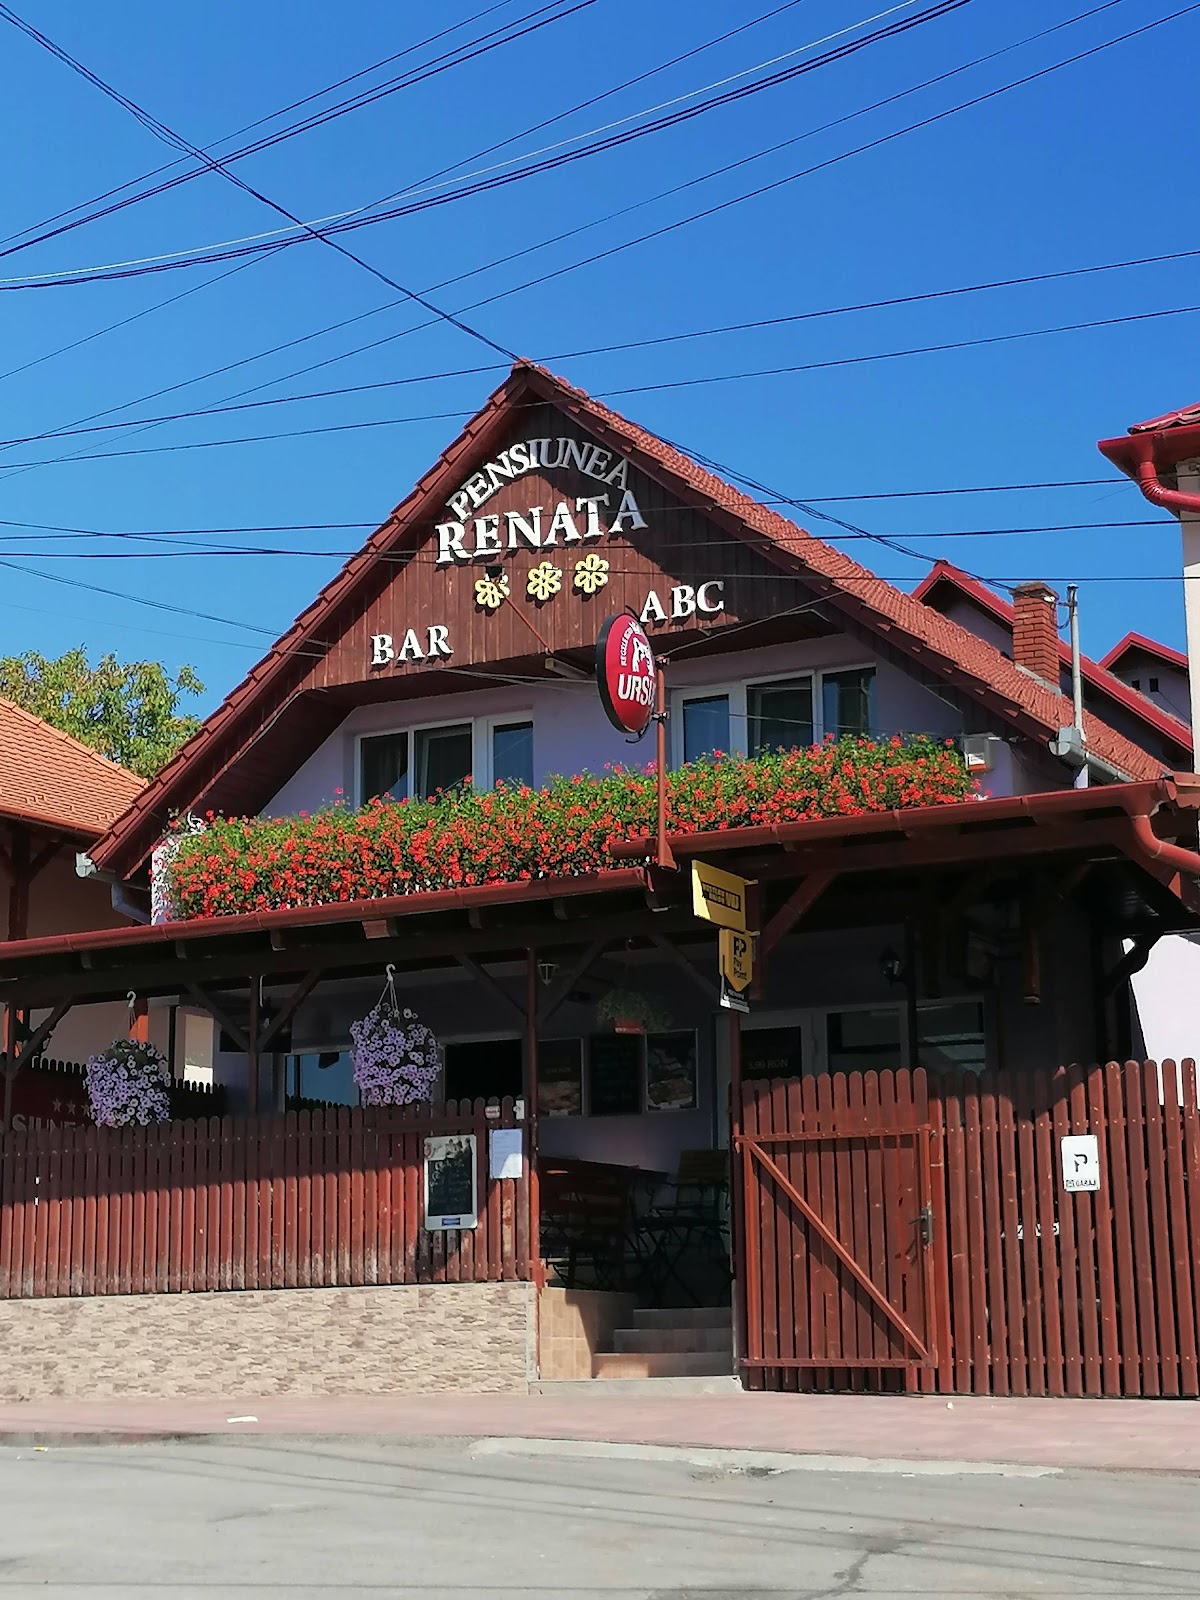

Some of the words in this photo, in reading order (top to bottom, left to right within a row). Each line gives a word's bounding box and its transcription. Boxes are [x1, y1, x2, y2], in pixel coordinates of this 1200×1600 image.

[445, 437, 629, 523] PENSIUNEA
[435, 489, 649, 564] RENATA
[639, 580, 725, 623] ABC
[370, 625, 454, 665] BAR
[617, 673, 657, 706] URSU
[1073, 1153, 1088, 1172] P
